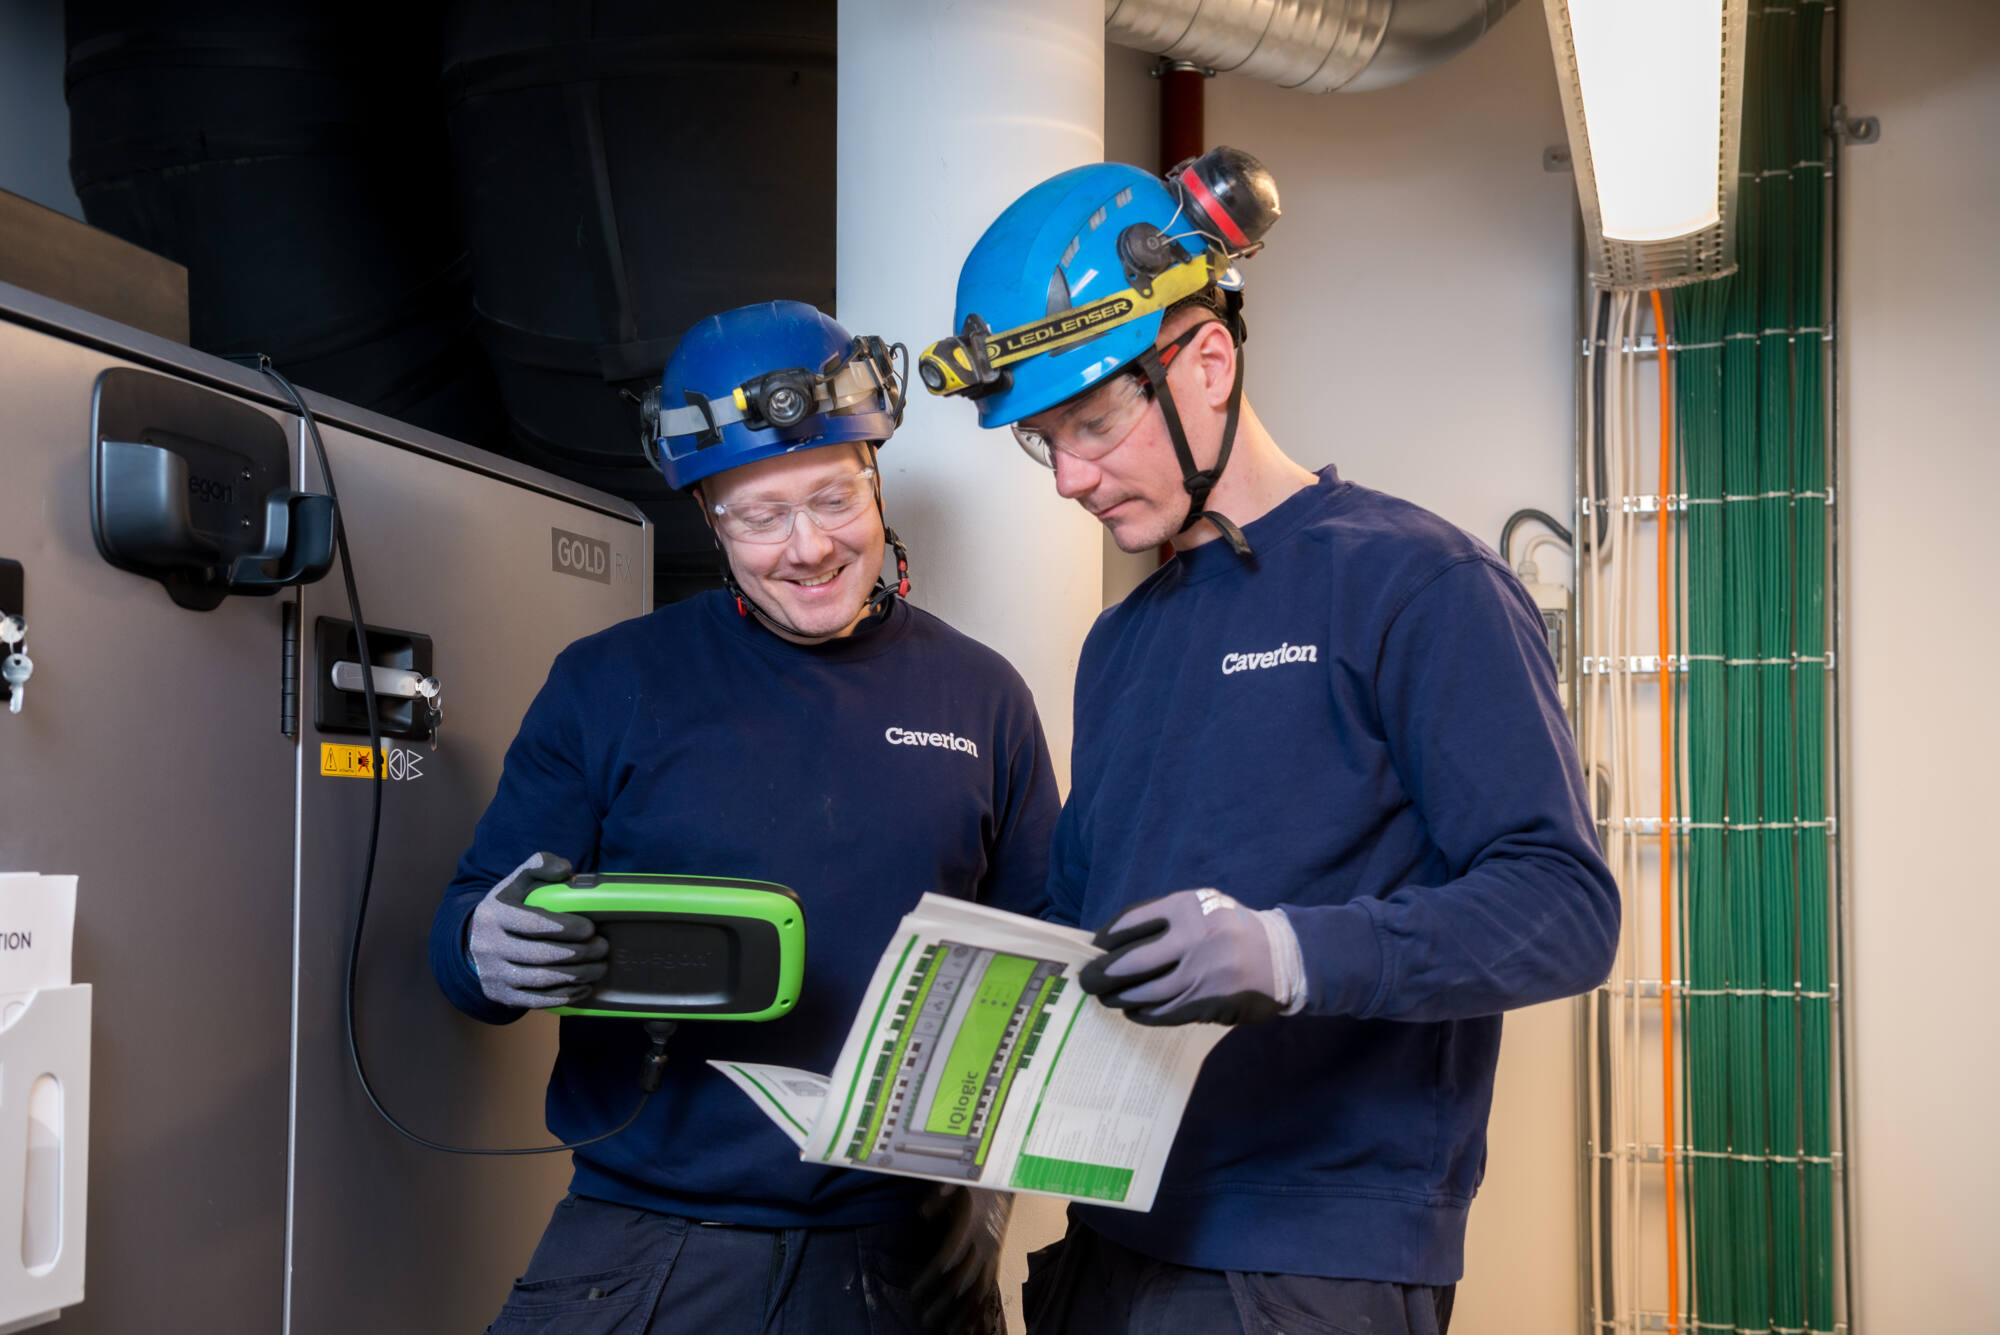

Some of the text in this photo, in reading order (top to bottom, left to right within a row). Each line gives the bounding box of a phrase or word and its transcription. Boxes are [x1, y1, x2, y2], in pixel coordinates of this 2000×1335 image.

[1006, 300, 1130, 351] LEDLENSER
[557, 536, 606, 575] GOLD
[1221, 642, 1318, 675] Caverion
[885, 726, 979, 758] Caverion
[947, 1071, 979, 1130] IQlogic
